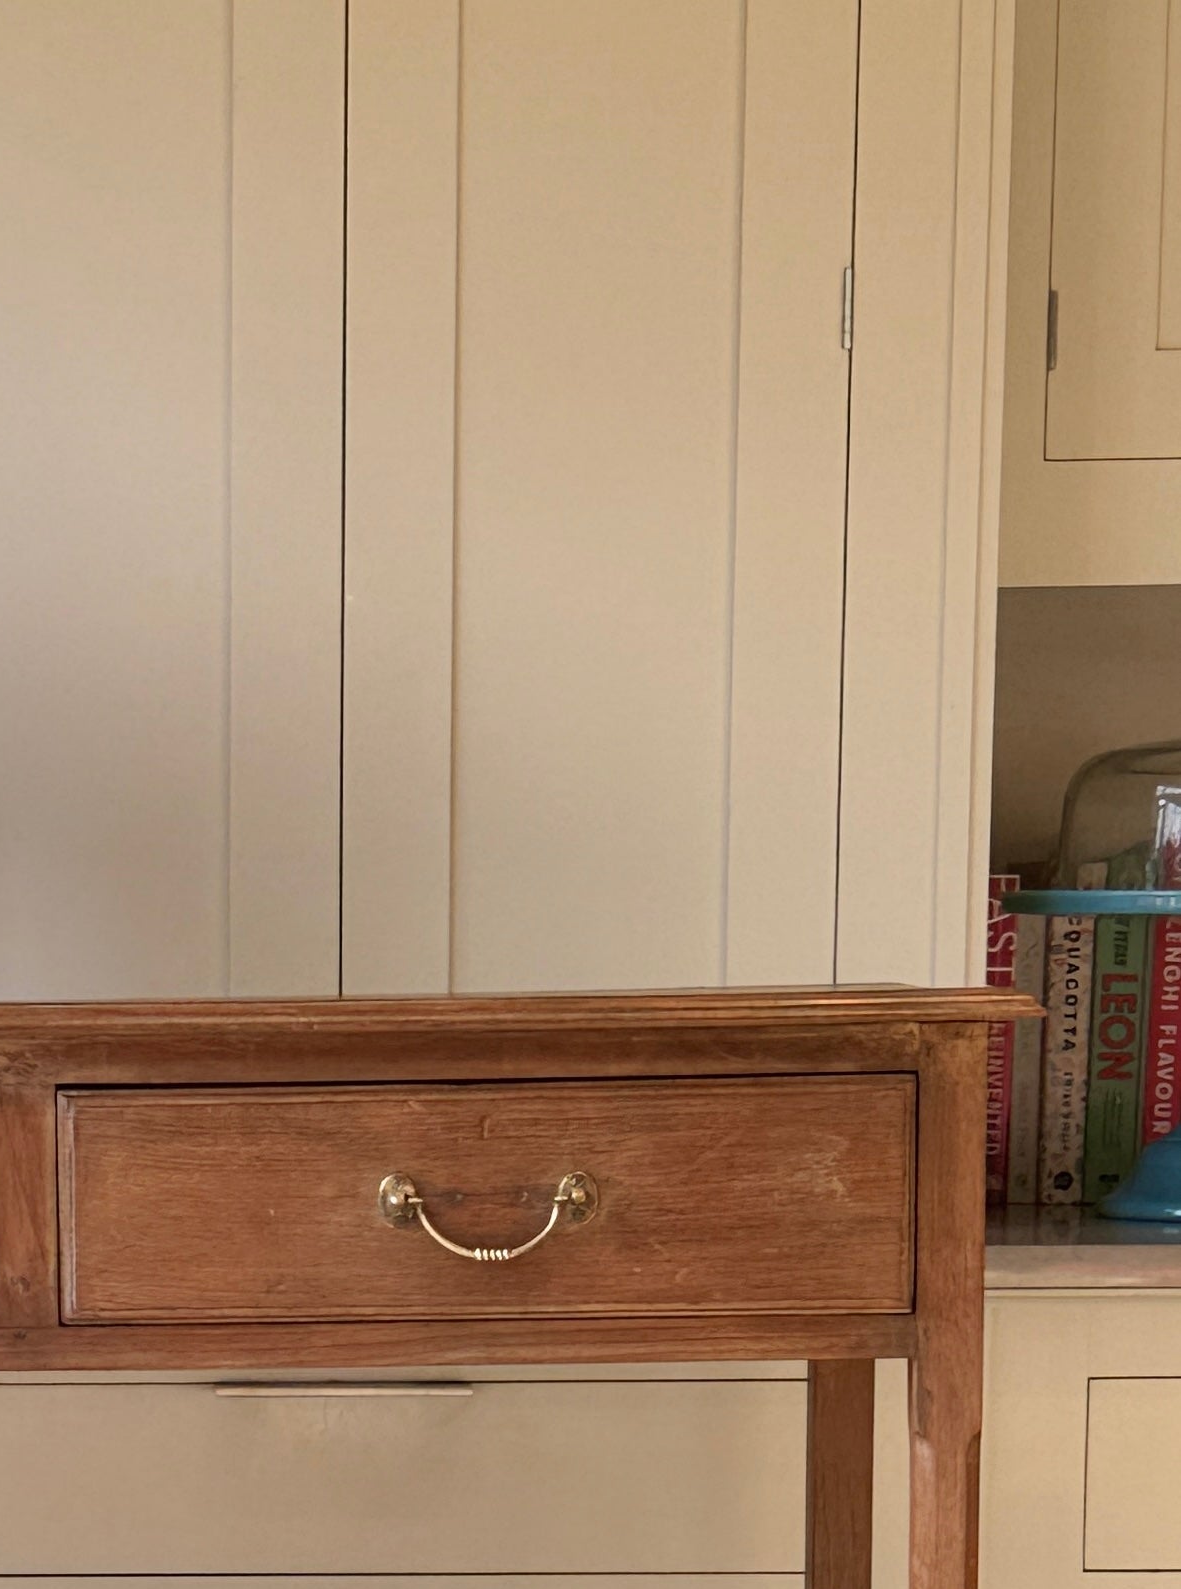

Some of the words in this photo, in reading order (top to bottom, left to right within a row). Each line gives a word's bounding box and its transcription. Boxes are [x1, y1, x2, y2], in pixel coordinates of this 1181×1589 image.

[1062, 916, 1082, 1051] CQUACOTTA
[1097, 973, 1139, 1082] LEON
[1152, 1024, 1178, 1135] FLAVOUR
